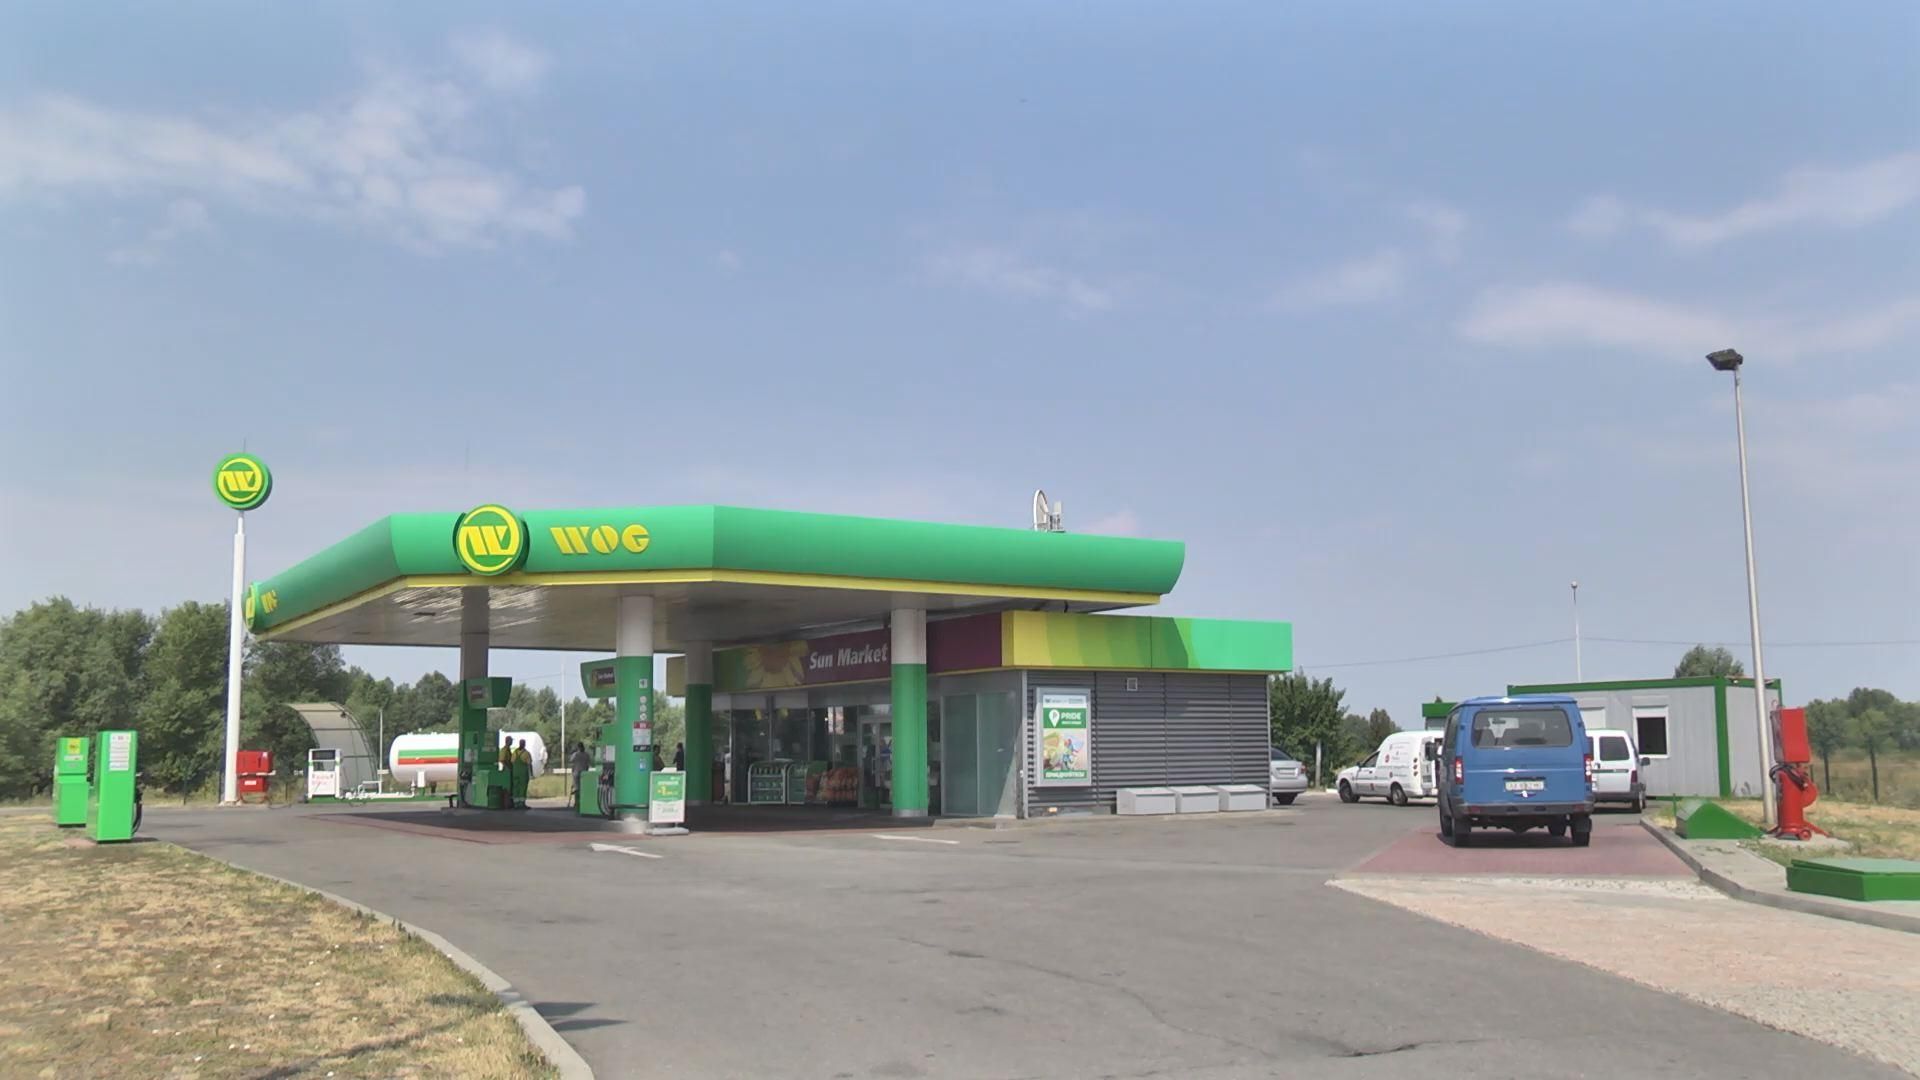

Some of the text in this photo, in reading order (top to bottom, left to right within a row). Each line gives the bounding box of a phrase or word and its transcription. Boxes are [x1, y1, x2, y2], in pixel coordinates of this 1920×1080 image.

[550, 524, 649, 555] WOG
[809, 643, 889, 670] Sun Market
[1060, 711, 1082, 721] PRIDE
